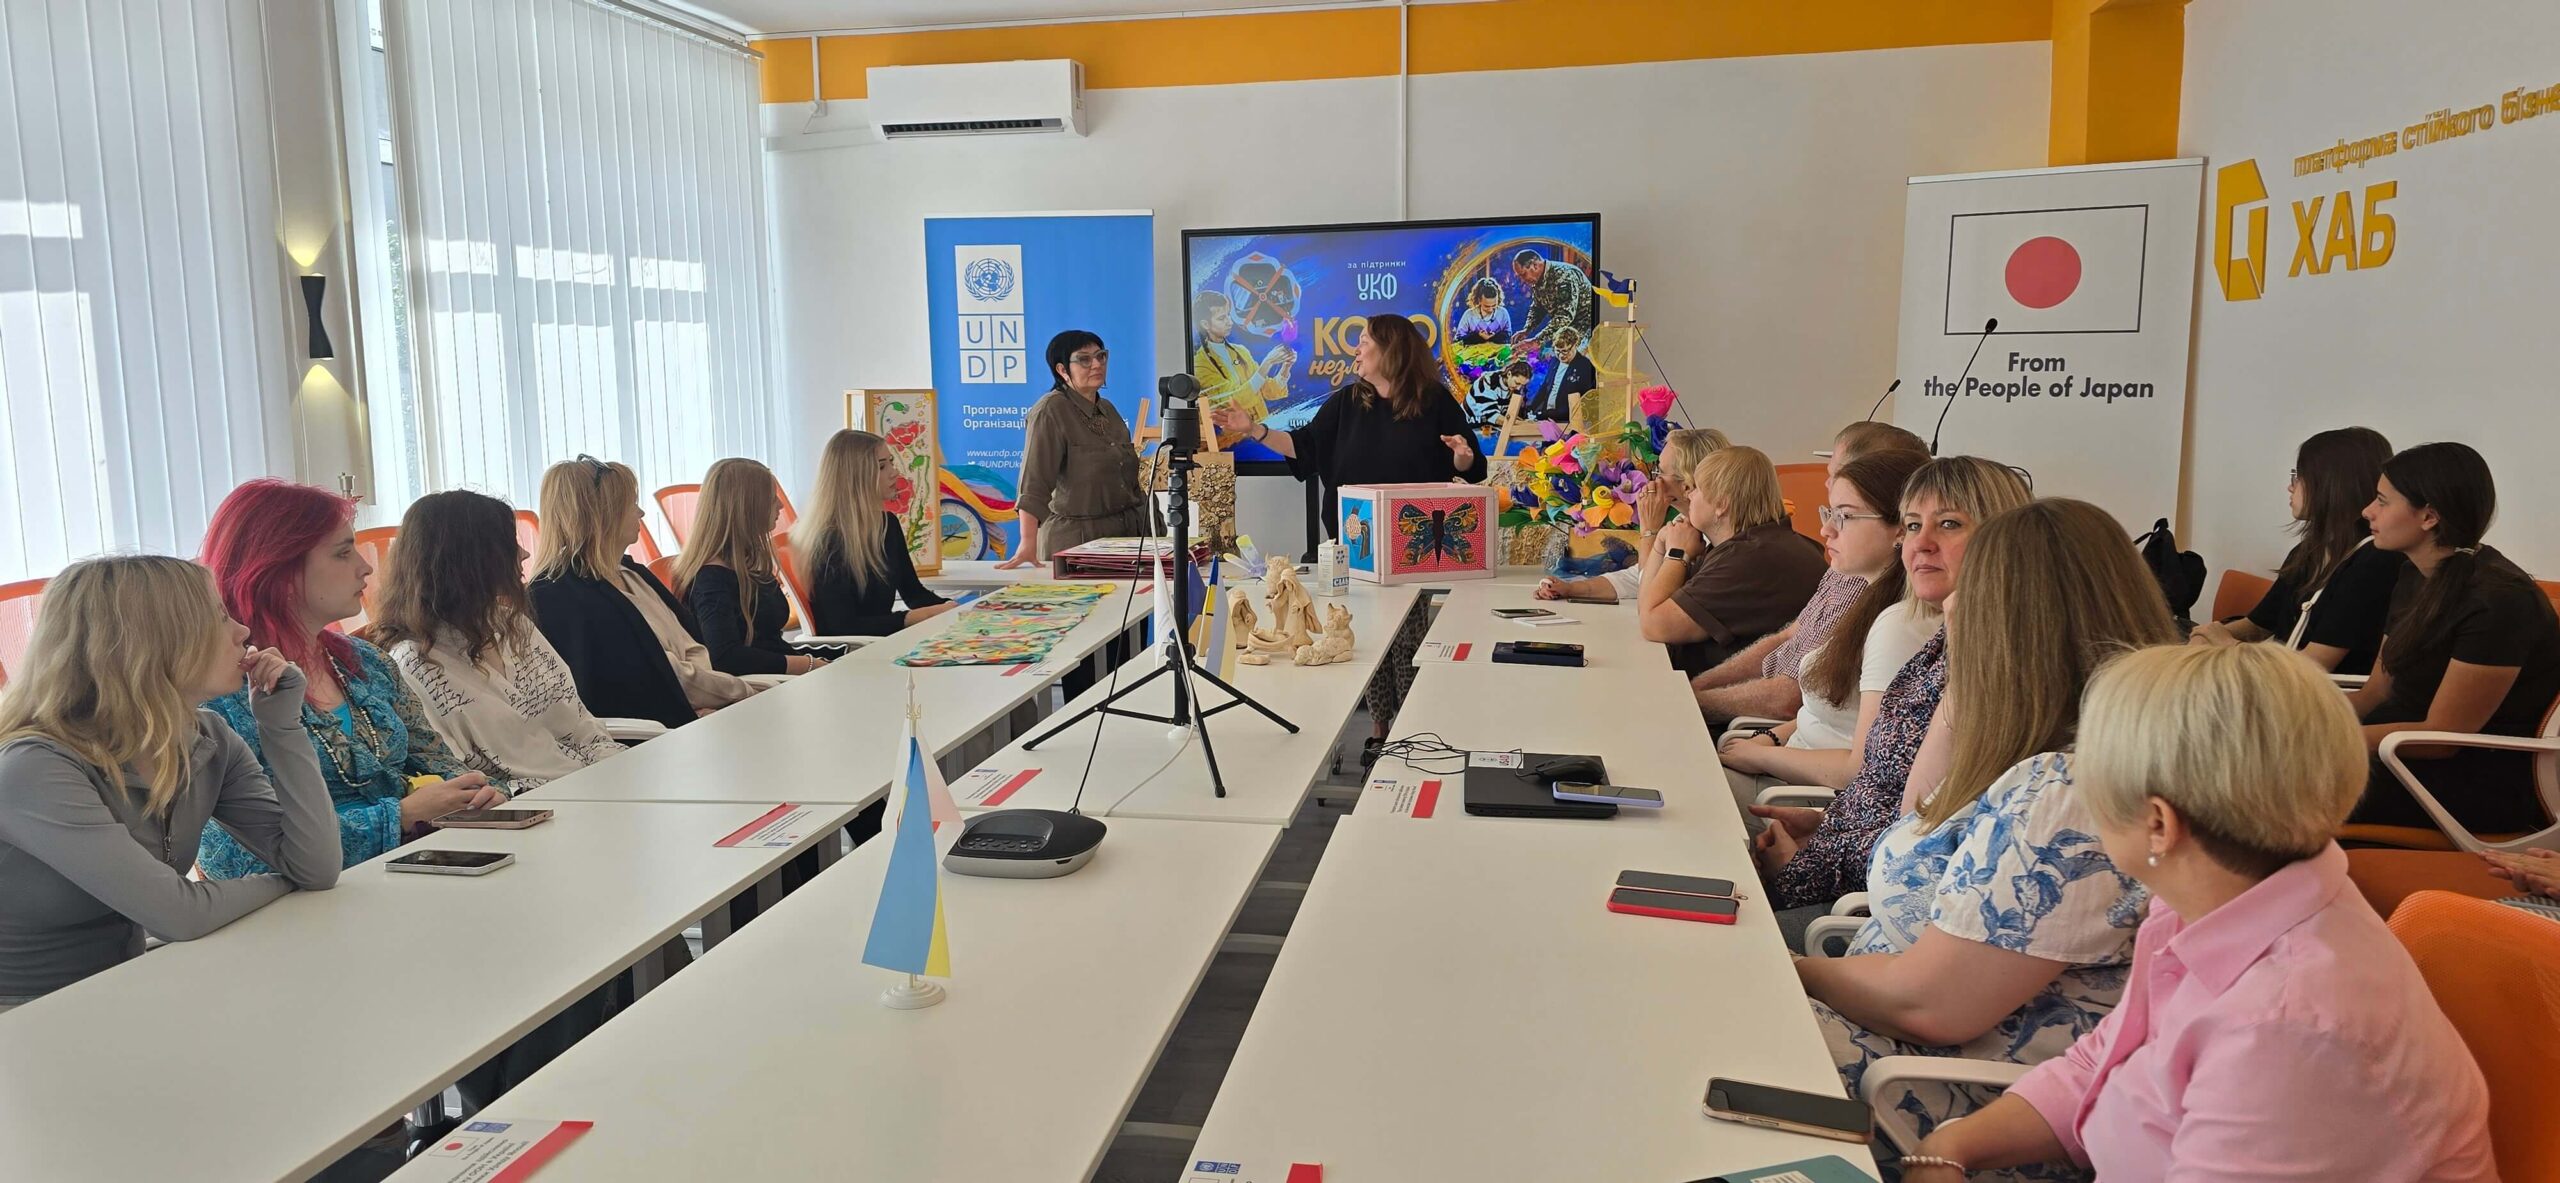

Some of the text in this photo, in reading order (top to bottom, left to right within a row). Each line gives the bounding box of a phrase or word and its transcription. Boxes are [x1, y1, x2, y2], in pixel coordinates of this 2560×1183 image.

[2288, 180, 2398, 277] ХАБ
[1361, 260, 1407, 270] підтримки
[1313, 313, 1438, 357] КОО
[2008, 352, 2066, 372] From
[1924, 376, 2154, 404] the People of Japan
[963, 405, 1018, 416] Програма
